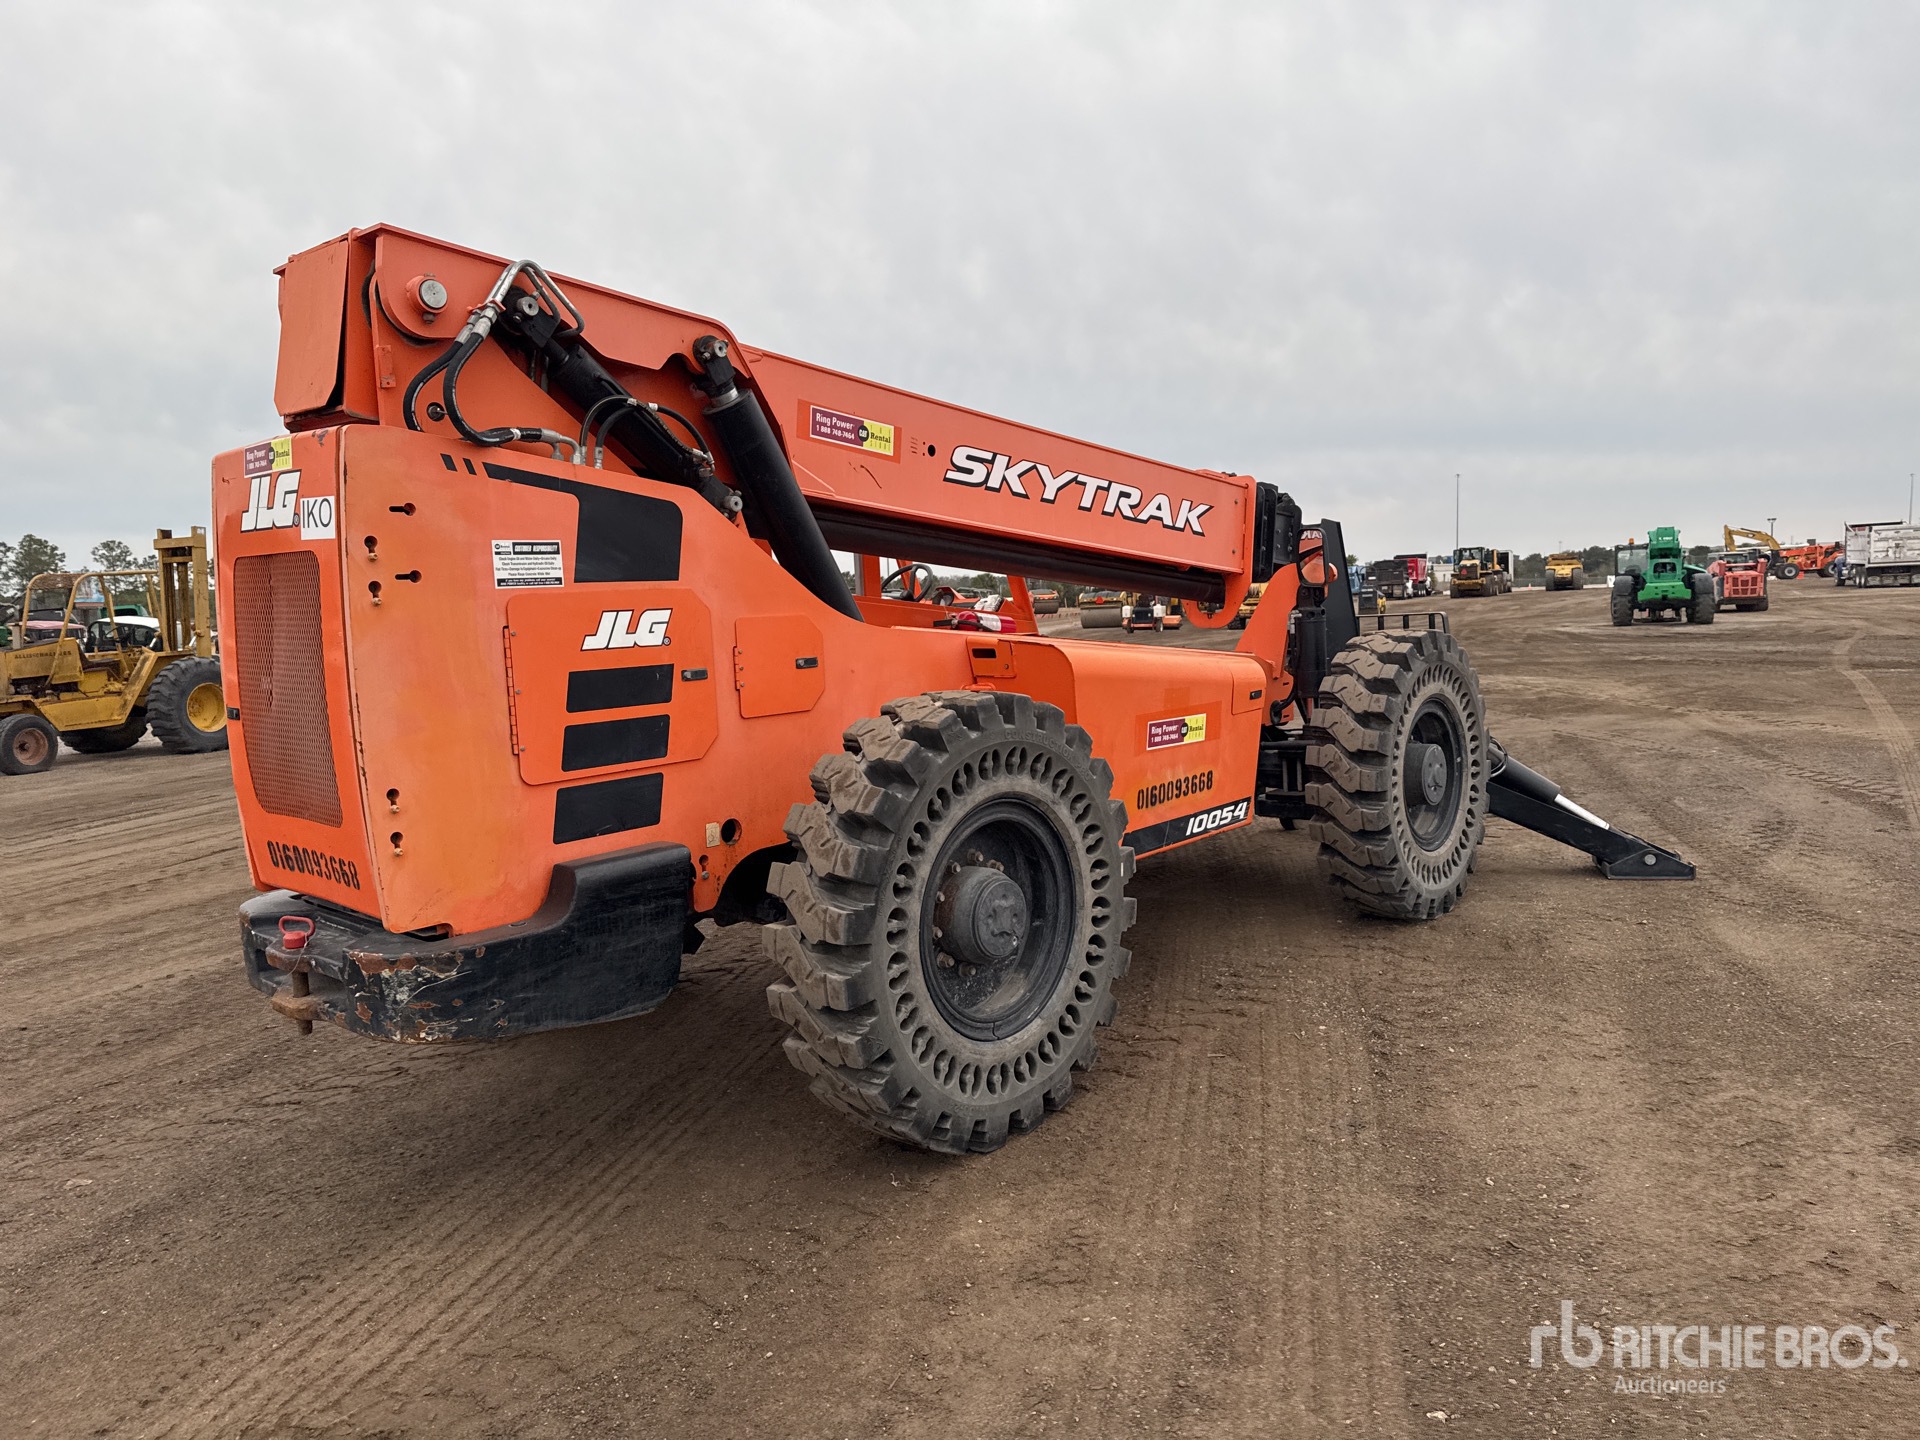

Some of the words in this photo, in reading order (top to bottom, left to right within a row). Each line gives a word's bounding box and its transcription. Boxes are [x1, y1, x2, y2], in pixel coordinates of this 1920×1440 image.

[816, 412, 831, 426] Ring
[832, 416, 854, 430] Power
[870, 431, 891, 444] Rental
[240, 469, 301, 533] JLG
[943, 444, 1214, 537] SKYTRAK
[302, 498, 333, 529] IKO
[580, 607, 673, 651] JLG
[1151, 726, 1162, 735] Ring
[1163, 724, 1178, 733] Power
[1189, 723, 1204, 733] Rental
[1136, 769, 1214, 811] 0160093668
[1185, 801, 1248, 836] 10054
[267, 840, 361, 891] 0160093668
